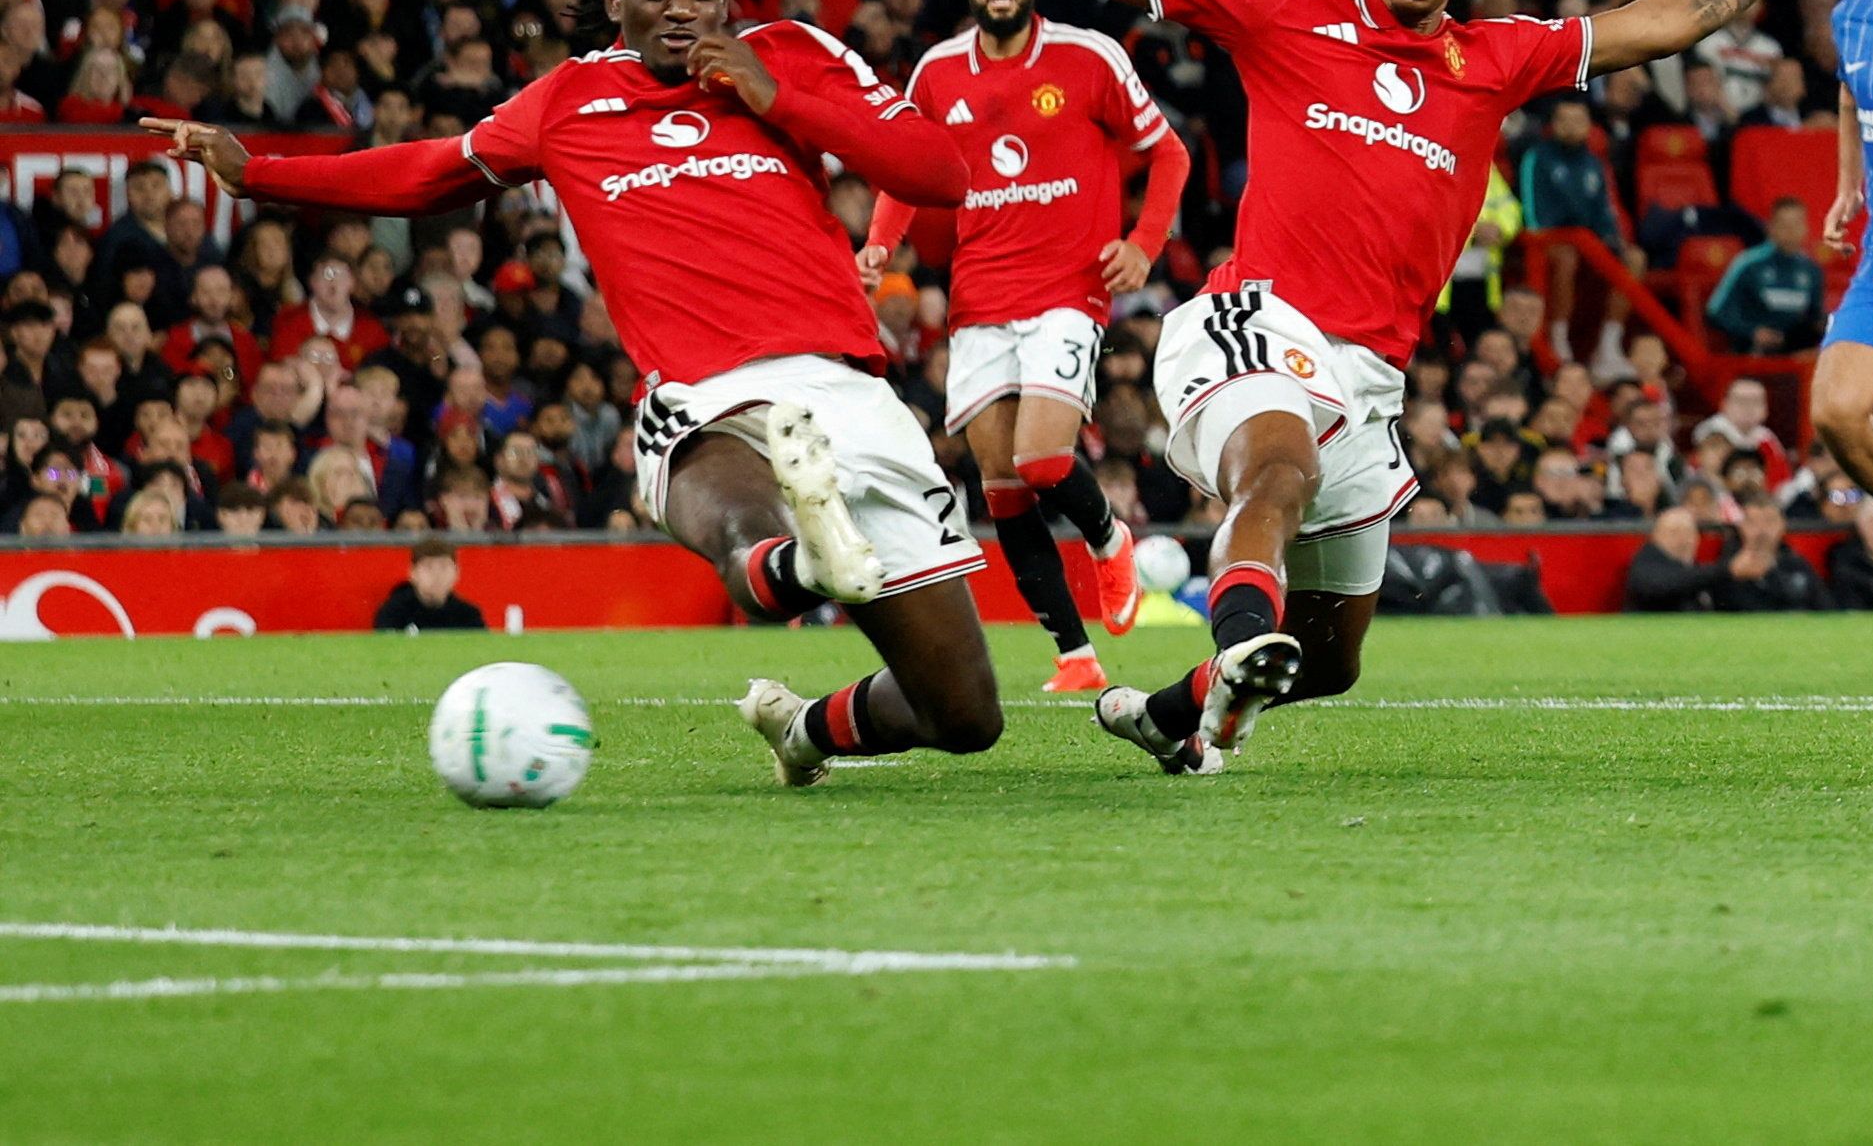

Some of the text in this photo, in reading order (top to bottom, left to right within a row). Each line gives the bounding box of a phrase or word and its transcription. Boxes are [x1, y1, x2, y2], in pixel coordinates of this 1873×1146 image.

[1305, 102, 1456, 175] Snapdragon
[600, 153, 788, 201] Snapdragon
[965, 177, 1078, 211] Snapdragon
